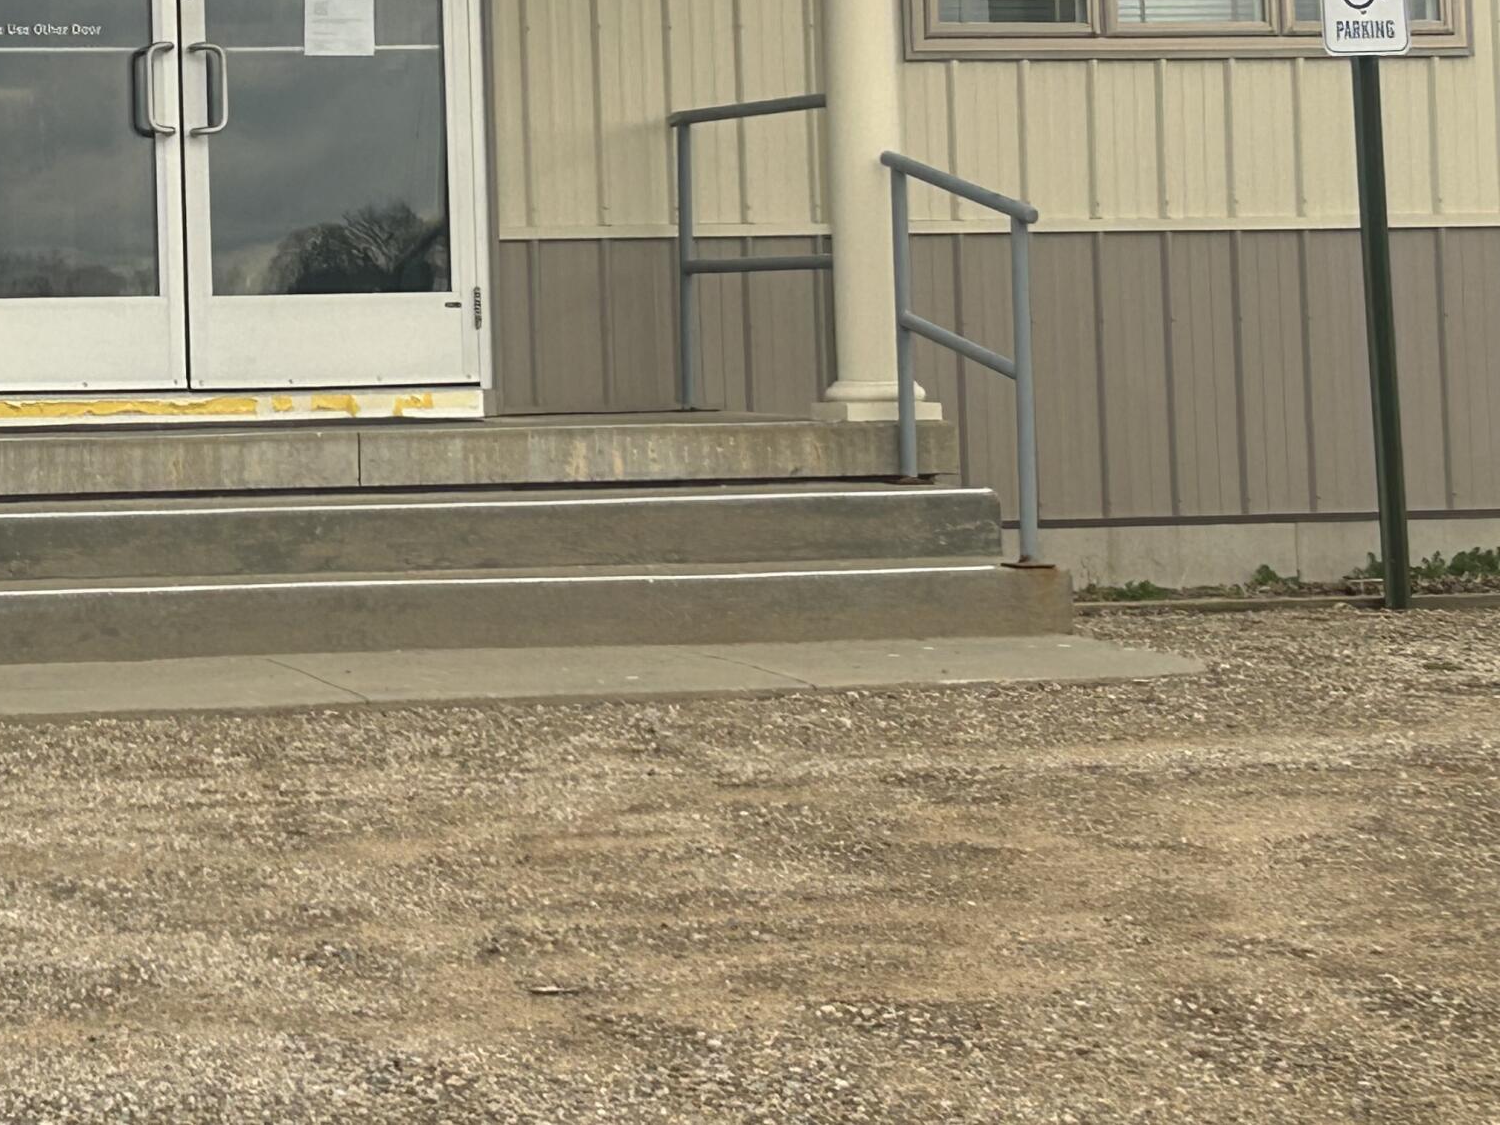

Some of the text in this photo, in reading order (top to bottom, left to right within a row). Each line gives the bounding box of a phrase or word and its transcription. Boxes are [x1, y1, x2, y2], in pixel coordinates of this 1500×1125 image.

[7, 23, 30, 35] Use
[33, 23, 69, 35] Other
[71, 23, 102, 35] Door
[1336, 20, 1396, 41] PARKING
